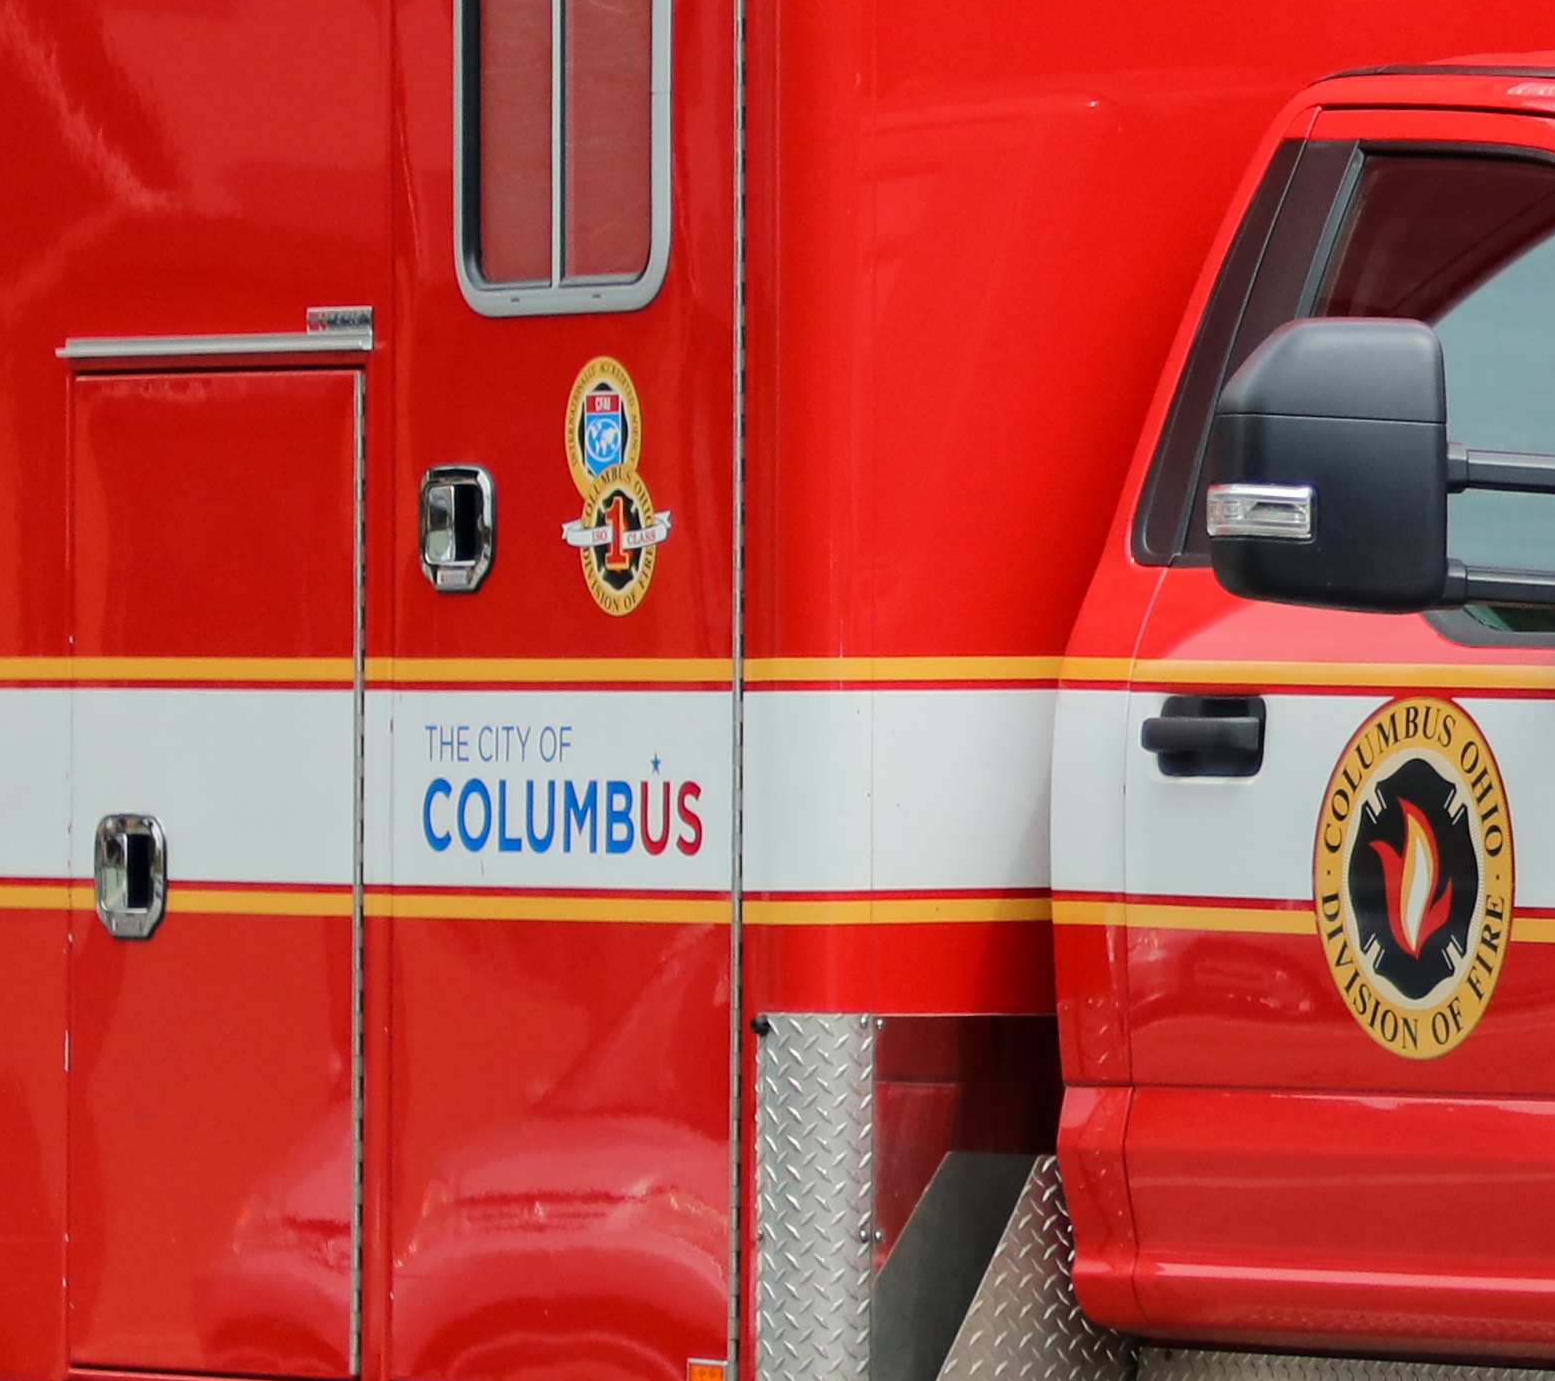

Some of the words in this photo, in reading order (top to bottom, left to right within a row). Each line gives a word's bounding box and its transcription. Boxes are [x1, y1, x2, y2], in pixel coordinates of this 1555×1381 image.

[591, 531, 608, 544] ISO
[627, 530, 656, 545] CLASS
[605, 496, 630, 570] 1
[582, 547, 620, 612] DIVISION
[623, 590, 637, 608] OF
[639, 547, 653, 588] FIRE
[425, 725, 469, 762] THE
[478, 725, 531, 762] CITY
[539, 725, 573, 762] OF
[423, 777, 703, 856] COLUMBUS
[1324, 705, 1456, 854] COLUMBUS
[1460, 741, 1504, 858] OHIO
[1321, 892, 1420, 1051] DIVISION
[1431, 996, 1464, 1047] OF
[1466, 893, 1505, 1002] FIRE
